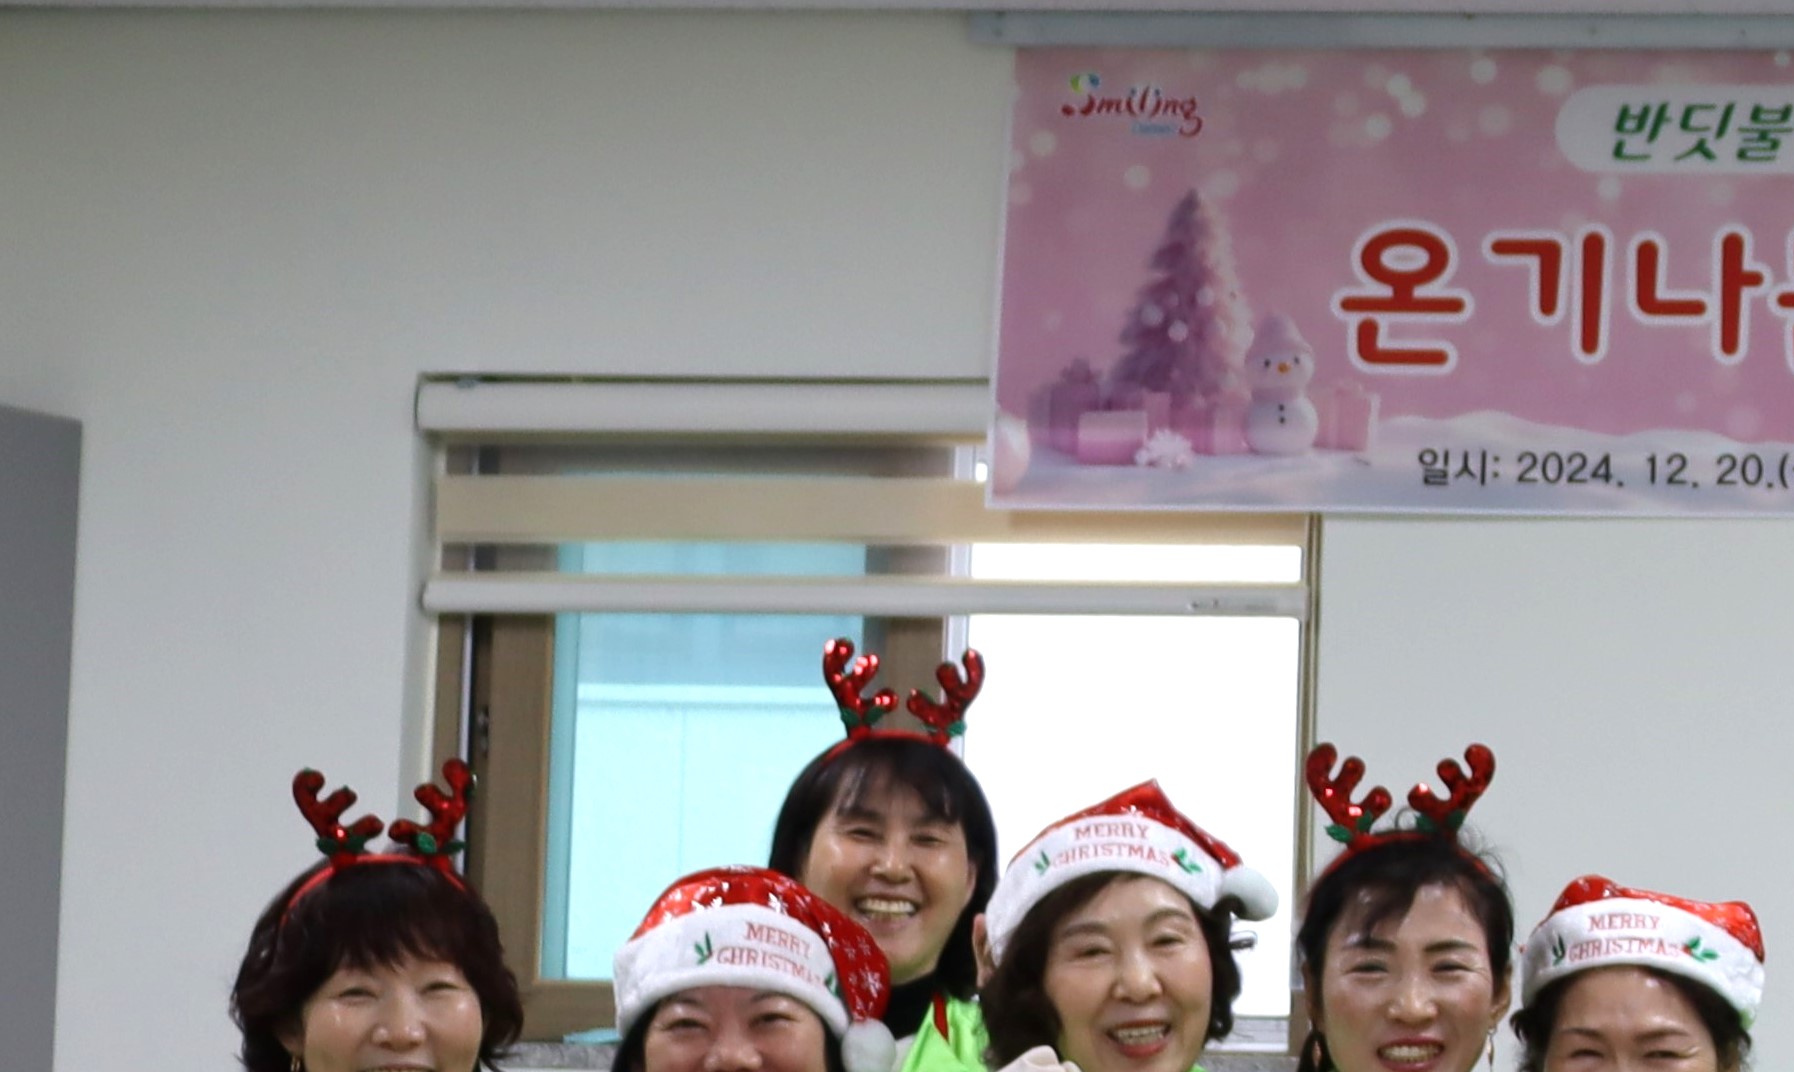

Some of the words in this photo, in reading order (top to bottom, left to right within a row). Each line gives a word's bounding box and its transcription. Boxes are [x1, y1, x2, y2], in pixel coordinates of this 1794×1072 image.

[1418, 449, 1499, 486] 일시:
[1517, 452, 1623, 487] 2024.
[1647, 454, 1698, 488] 12.
[1075, 822, 1149, 841] MERRY
[1588, 912, 1661, 932] MERRY
[743, 921, 811, 959] MERRY
